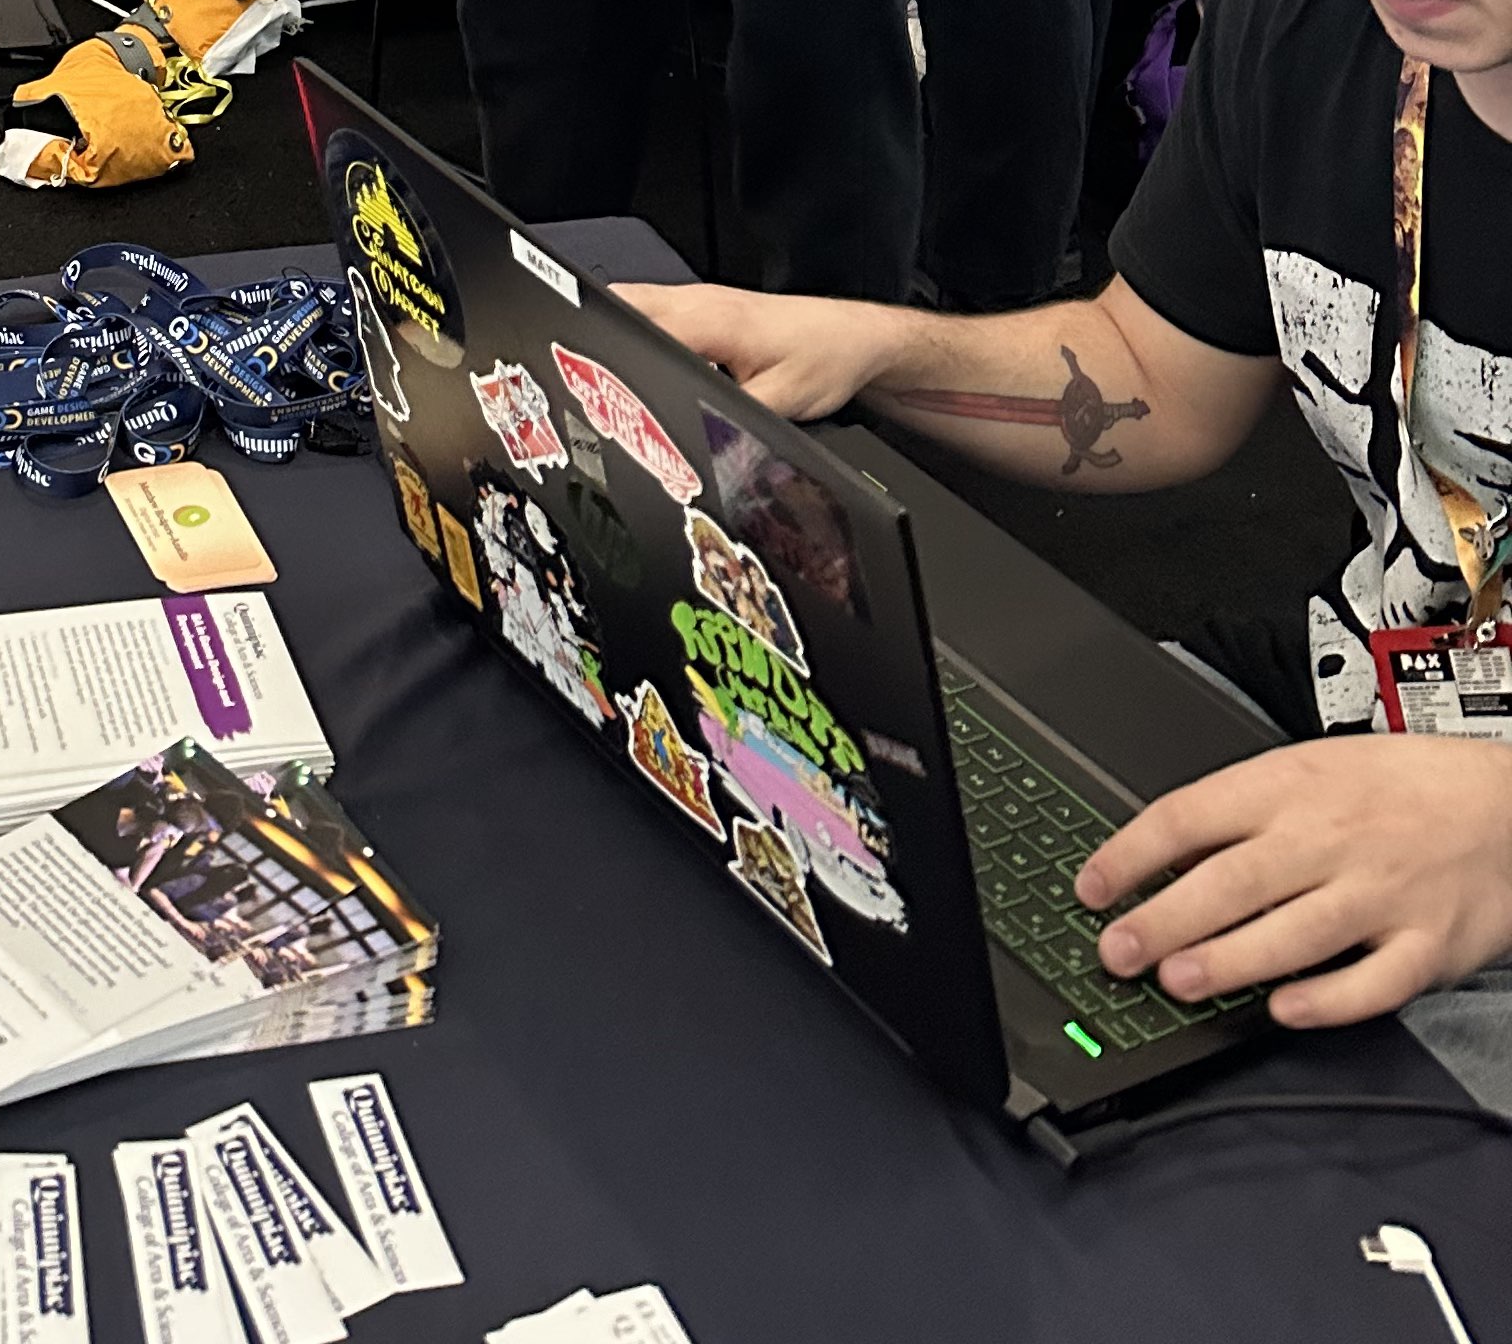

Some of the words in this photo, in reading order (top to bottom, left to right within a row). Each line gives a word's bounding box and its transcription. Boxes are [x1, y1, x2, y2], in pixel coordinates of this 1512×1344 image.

[120, 250, 189, 293] Quinnipiac
[231, 285, 275, 305] Quin
[525, 249, 562, 286] MATT
[370, 260, 441, 343] MARKET
[271, 317, 296, 344] GAME
[201, 353, 271, 408] DEVELOPMENT
[208, 344, 235, 369] GAME
[231, 362, 266, 396] DESIGN
[26, 405, 55, 417] GAME
[232, 602, 265, 662] Quinnipiac
[331, 1110, 358, 1160] College
[359, 1181, 377, 1211] Arts
[349, 1088, 409, 1209] Quinnipiac
[9, 1198, 30, 1251] College
[156, 1153, 200, 1284] Quinnipiac
[205, 1164, 232, 1212] College
[236, 1231, 256, 1266] Arts
[222, 1140, 289, 1260] Quinnipiac
[33, 1177, 69, 1309] Quinnipiac
[136, 1175, 155, 1228] College
[147, 1252, 164, 1285] Arts
[16, 1275, 33, 1306] Arts
